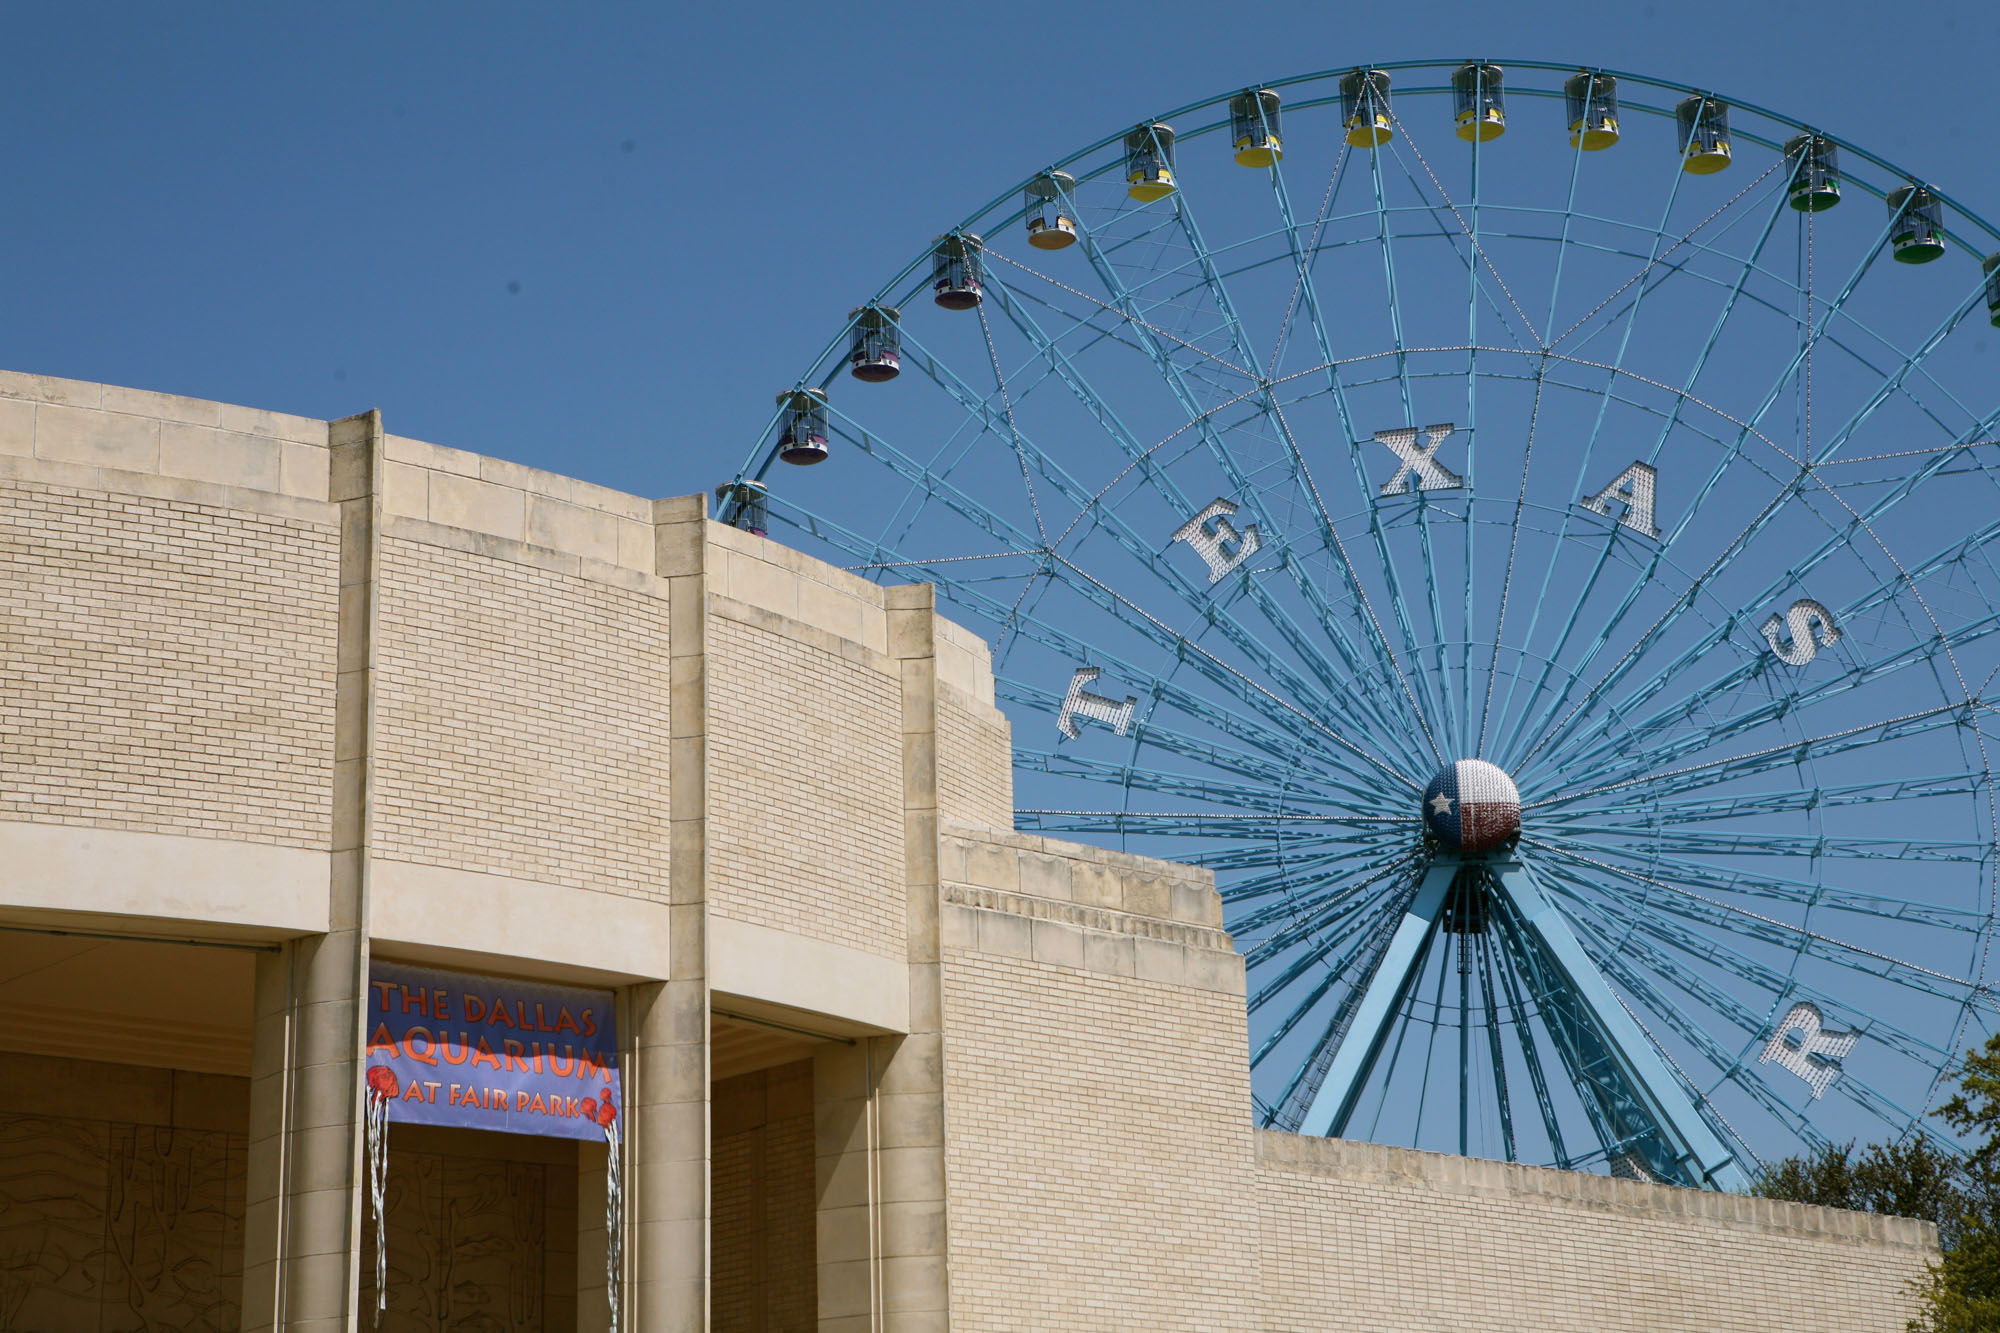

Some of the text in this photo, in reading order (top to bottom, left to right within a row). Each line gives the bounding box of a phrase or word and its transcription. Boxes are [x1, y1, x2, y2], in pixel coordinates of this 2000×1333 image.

[1056, 423, 1842, 741] TEXAS
[372, 980, 597, 1037] THE DALLAS
[366, 1021, 612, 1083] AQUARIUM
[403, 1079, 579, 1118] AT FAIR PARK
